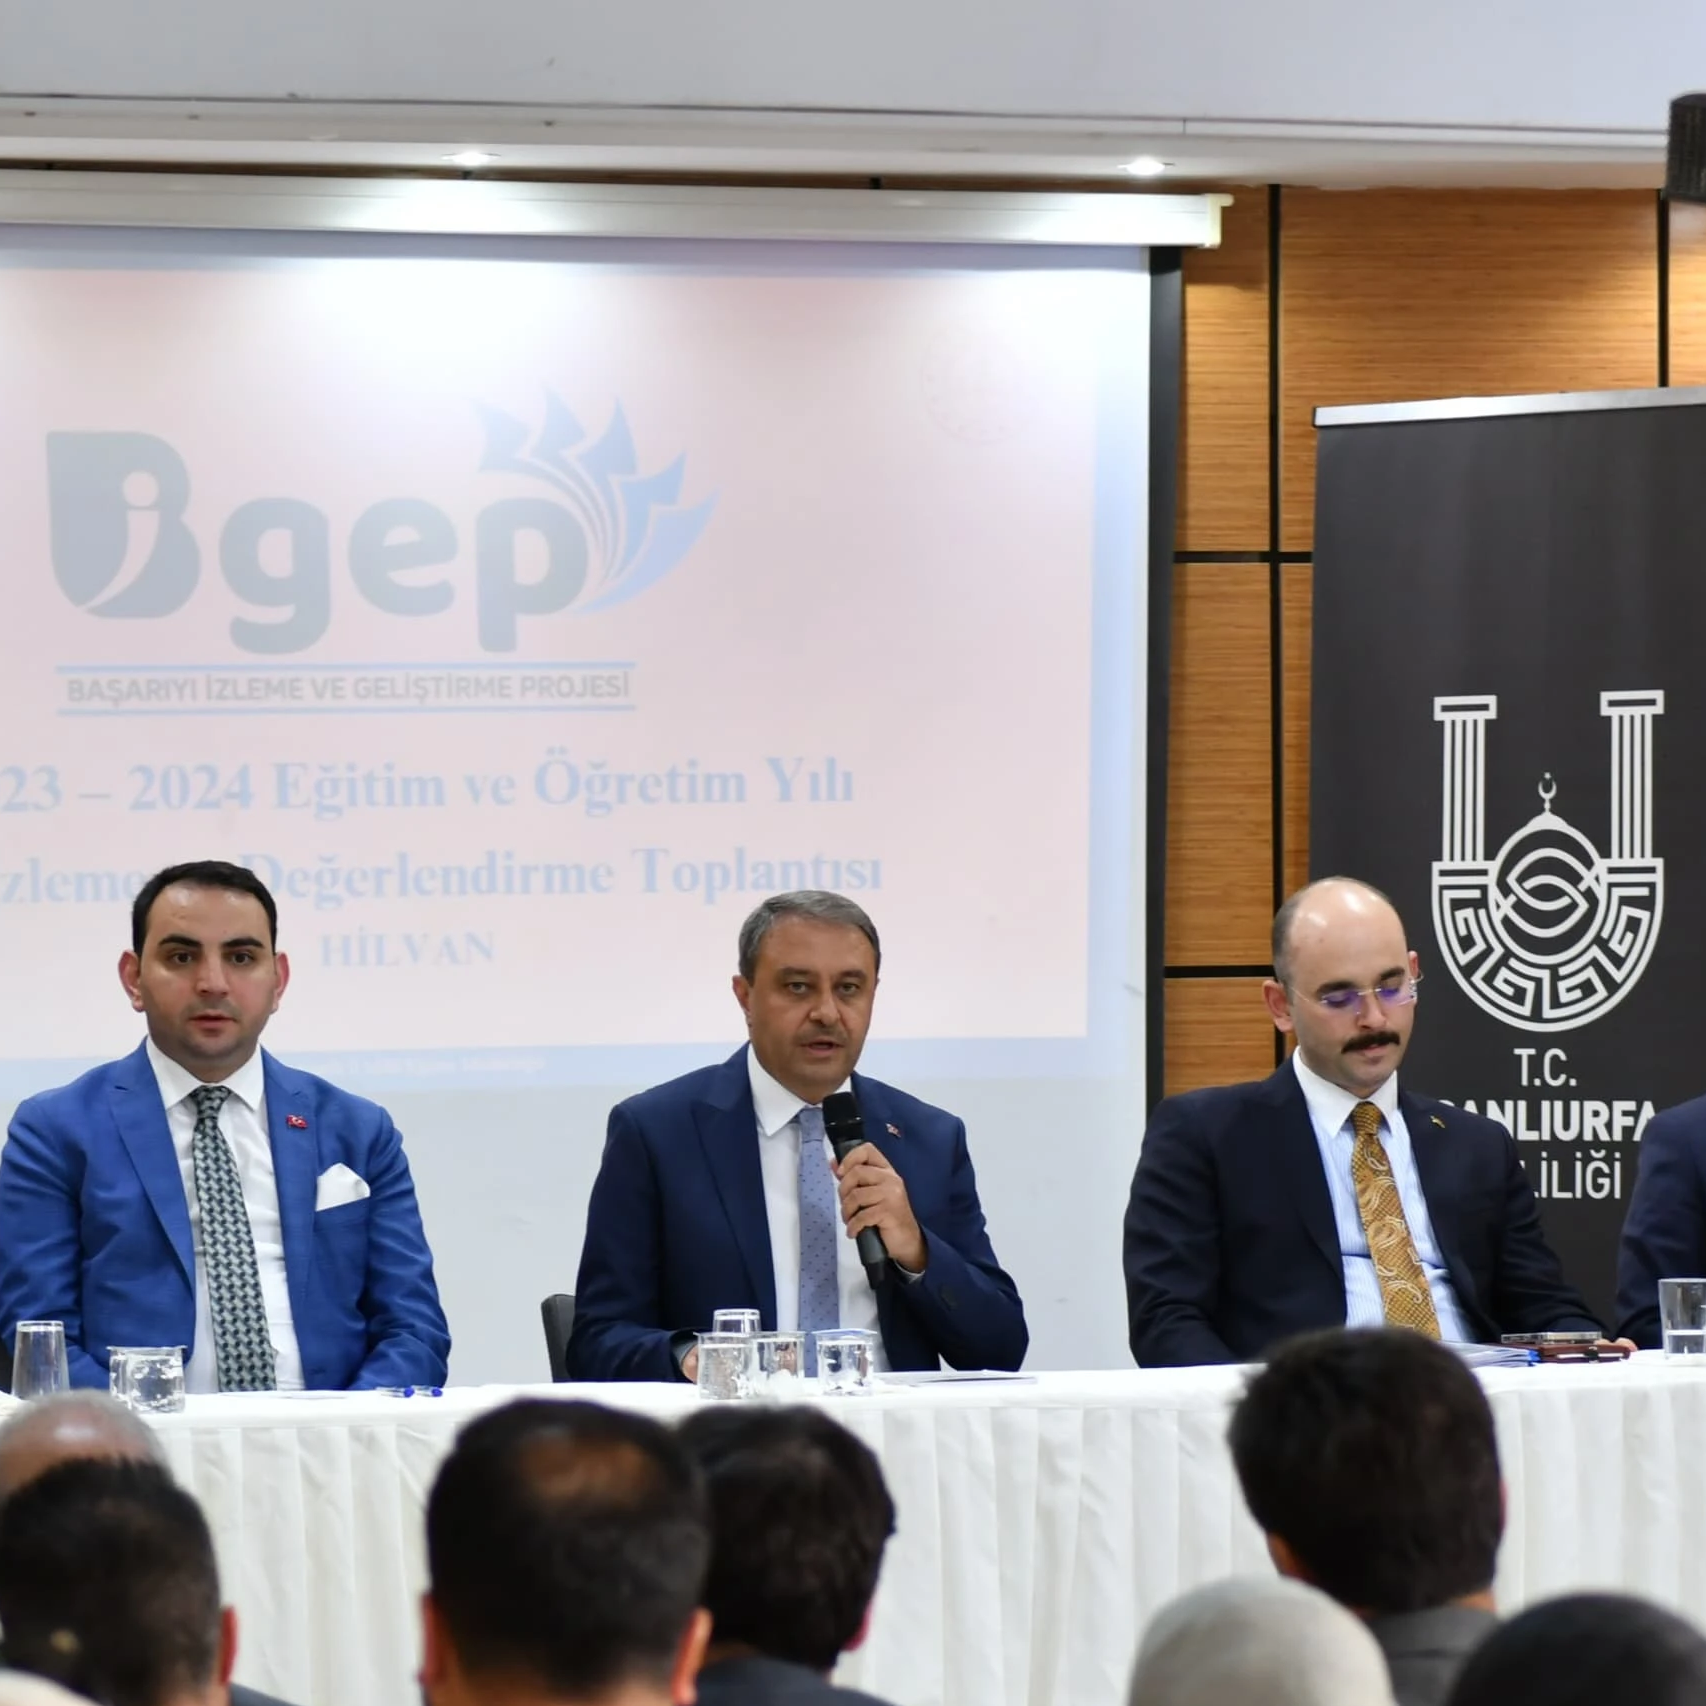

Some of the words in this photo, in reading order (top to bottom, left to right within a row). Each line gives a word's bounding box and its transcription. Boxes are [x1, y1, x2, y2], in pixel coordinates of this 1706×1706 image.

[67, 677, 198, 708] BAŞARIYI
[205, 673, 298, 702] İZLEME
[308, 677, 346, 701] VE
[353, 672, 513, 705] GELİŞTİRME
[520, 670, 630, 699] PROJESİ
[128, 762, 255, 812] 2024
[272, 760, 447, 821] Eğitim
[463, 773, 517, 806] ve
[533, 745, 747, 818] Öğretim
[766, 755, 854, 804] Yılı
[238, 851, 615, 910] Değerlendirme
[631, 846, 883, 906] Toplantısı
[320, 924, 495, 969] HİLVAN
[1513, 1048, 1577, 1087] T.C.
[1439, 1100, 1656, 1141] NLIURFA
[1521, 1150, 1621, 1199] İLİĞİ
